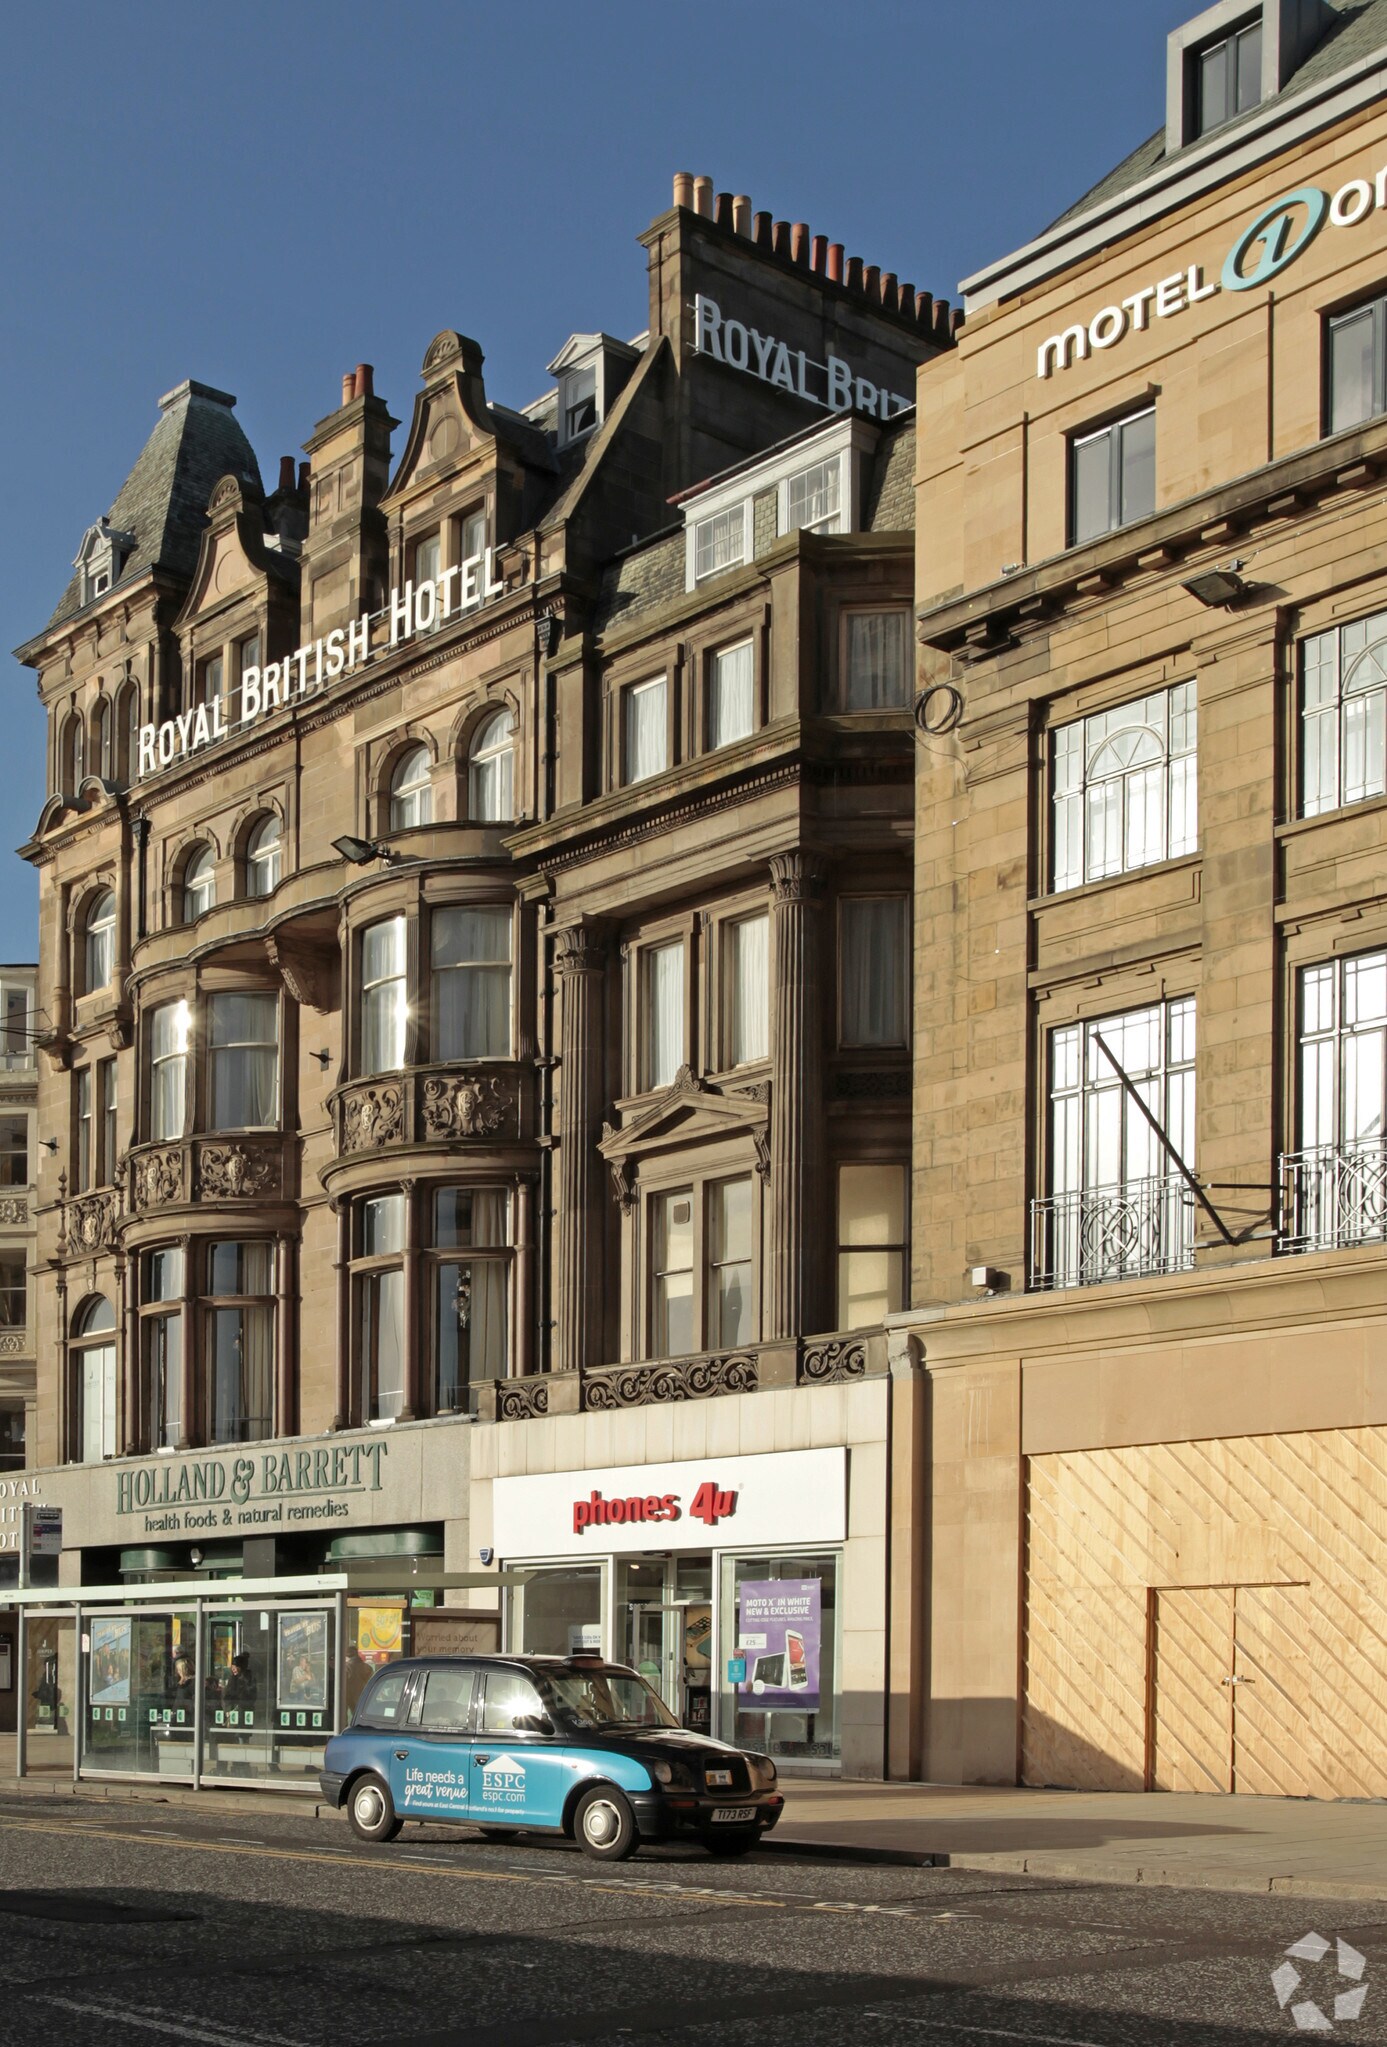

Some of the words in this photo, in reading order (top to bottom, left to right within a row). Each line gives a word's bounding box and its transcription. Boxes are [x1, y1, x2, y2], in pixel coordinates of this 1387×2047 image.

[138, 694, 229, 777] ROYAL
[241, 612, 370, 722] BRITISH
[390, 547, 503, 646] HOTEL
[116, 1461, 225, 1514] HOLLAND
[230, 1458, 255, 1505] &
[261, 1441, 388, 1493] BARRETT
[144, 1513, 180, 1532] health
[184, 1509, 217, 1528] foods
[222, 1508, 233, 1525] &
[238, 1503, 282, 1524] natural
[287, 1499, 349, 1521] remedies
[573, 1490, 680, 1534] phones
[690, 1482, 738, 1525] 4u
[746, 1599, 767, 1607] MOTO
[777, 1598, 787, 1606] IN
[787, 1597, 811, 1606] WHITE
[746, 1608, 763, 1616] NEW
[764, 1607, 769, 1616] &
[770, 1606, 809, 1615] EXCLUSIVE
[406, 1768, 423, 1781] Life
[425, 1770, 456, 1783] needs
[457, 1774, 464, 1784] a
[482, 1772, 526, 1788] ESPC
[404, 1783, 433, 1806] great
[435, 1785, 468, 1800] venue
[482, 1791, 526, 1802] espc.com
[718, 1810, 737, 1820] T173
[738, 1809, 753, 1819] RSF
